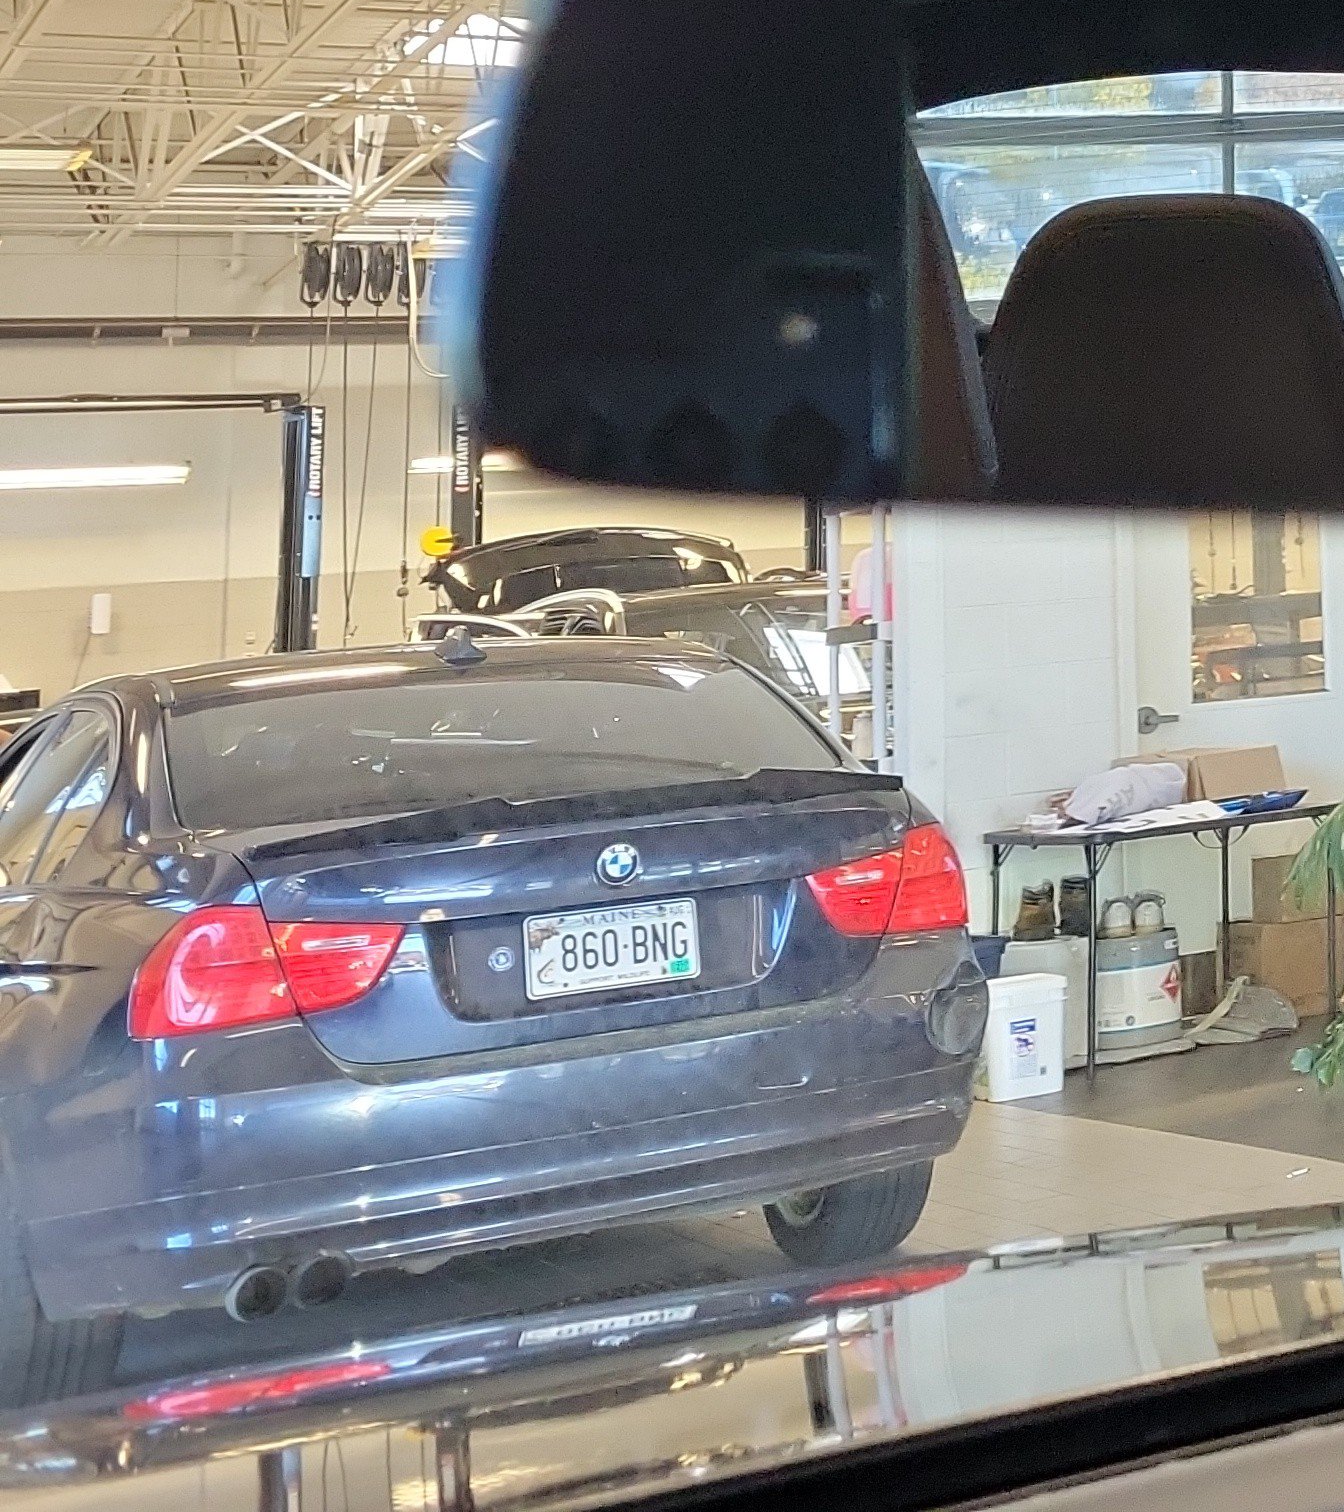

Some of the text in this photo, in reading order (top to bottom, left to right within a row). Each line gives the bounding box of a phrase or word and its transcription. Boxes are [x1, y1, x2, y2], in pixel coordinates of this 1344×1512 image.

[309, 407, 324, 490] ROTARY LIFT
[456, 434, 469, 486] ROTARY
[582, 909, 640, 926] MAINE
